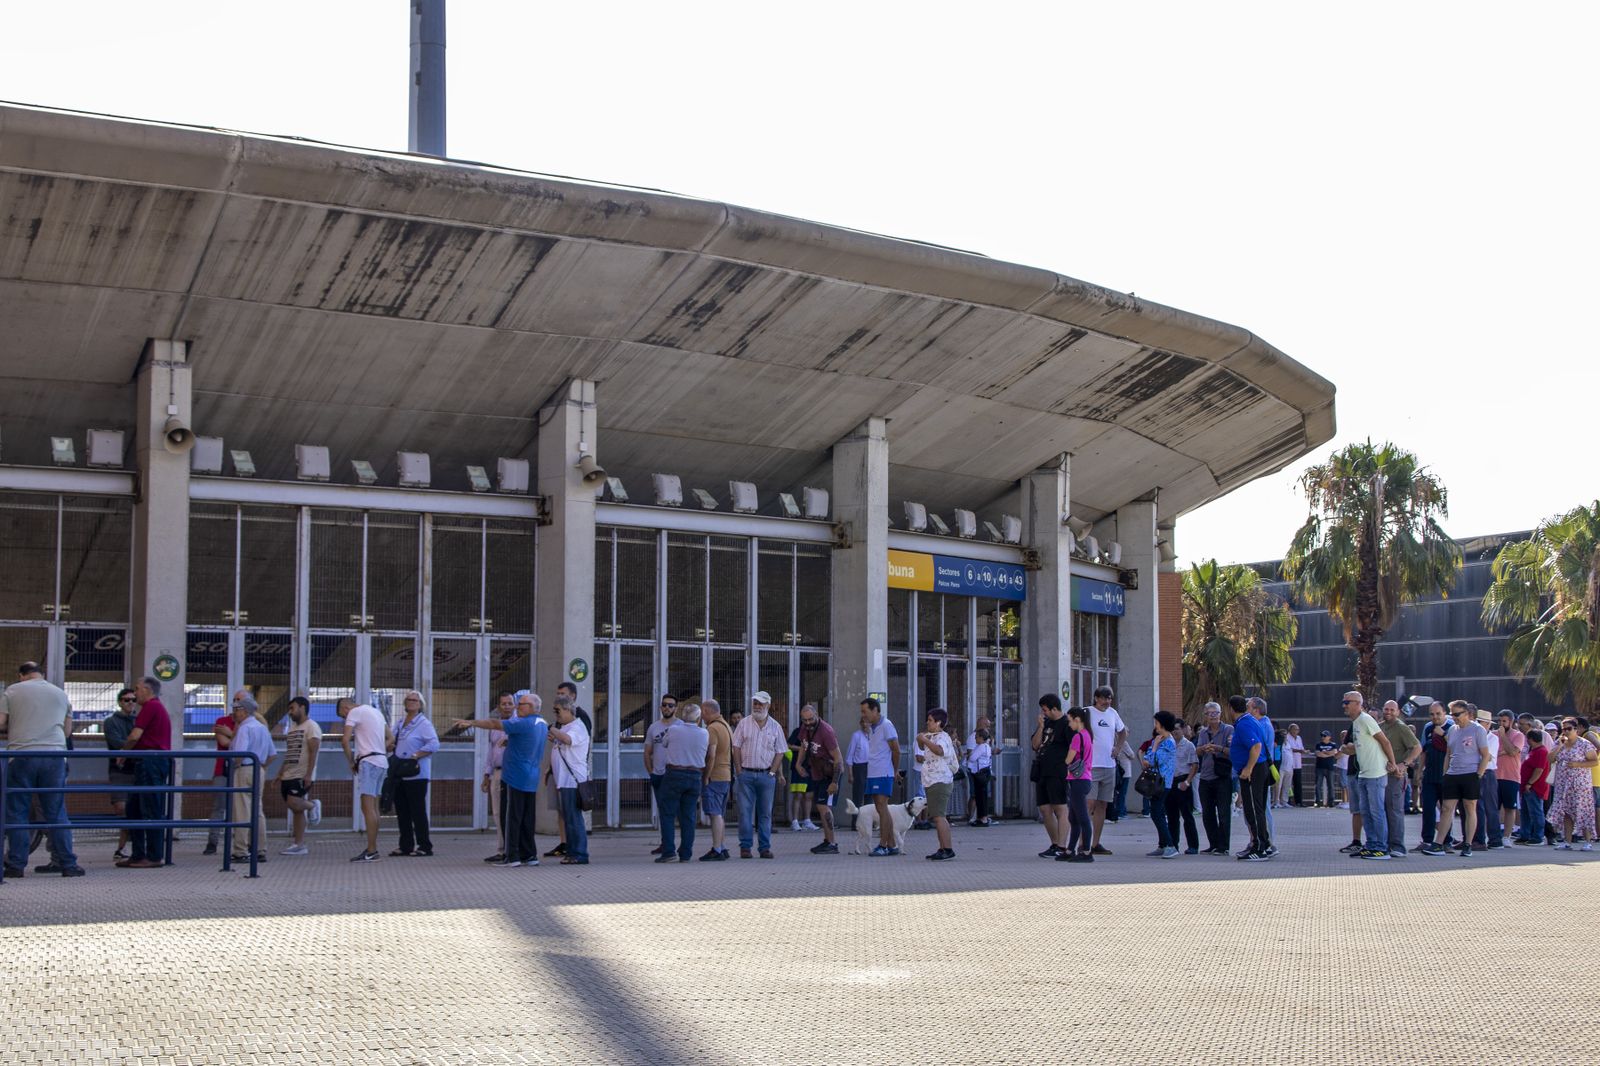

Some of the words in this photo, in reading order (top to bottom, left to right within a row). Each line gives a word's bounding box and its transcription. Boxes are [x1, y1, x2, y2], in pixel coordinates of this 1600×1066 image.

[938, 566, 960, 577] Sectores
[982, 571, 991, 582] 10
[998, 573, 1007, 583] 41
[1014, 575, 1023, 585] 43
